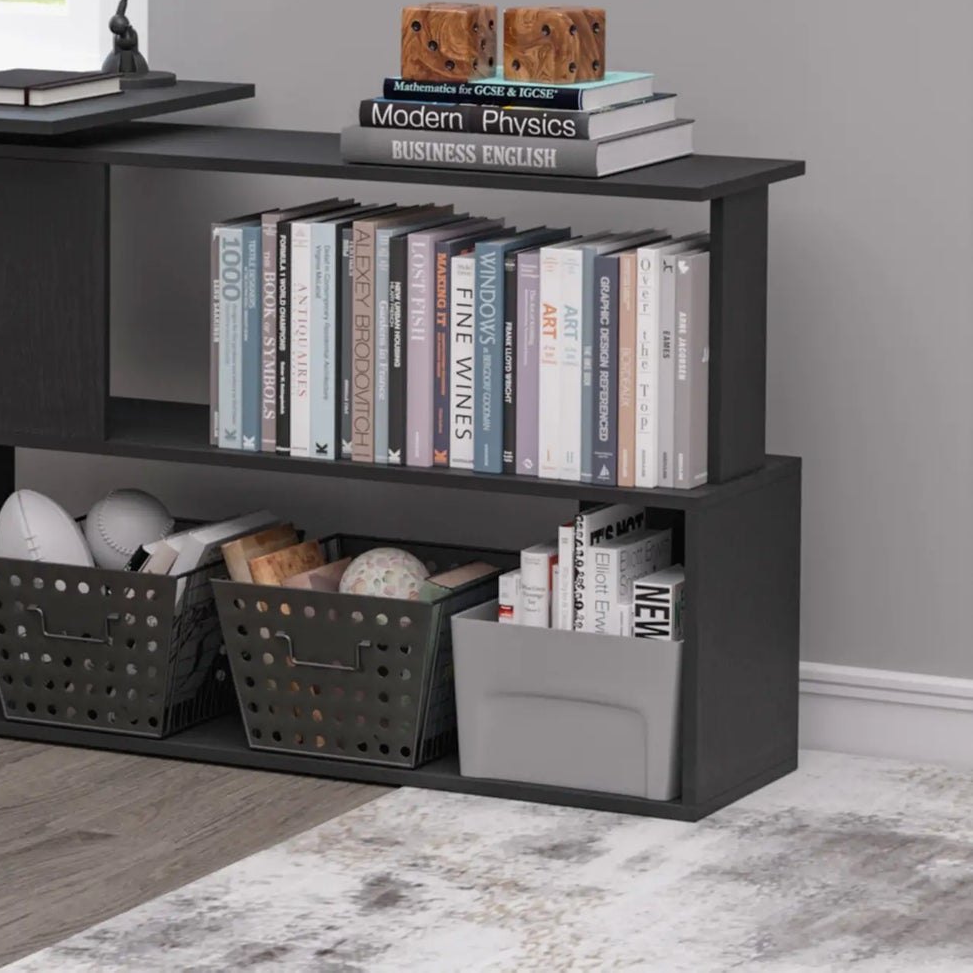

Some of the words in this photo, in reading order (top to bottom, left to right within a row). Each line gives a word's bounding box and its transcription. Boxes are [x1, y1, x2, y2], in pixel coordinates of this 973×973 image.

[393, 80, 457, 95] Mathematics
[458, 83, 473, 96] for
[474, 84, 505, 98] GCSE
[506, 86, 517, 98] &
[371, 101, 464, 131] Modern
[482, 109, 577, 138] Physics
[391, 139, 477, 164] BUSINESS
[482, 144, 557, 168] ENGLISH
[222, 237, 241, 302] 1000
[279, 235, 287, 271] FORMULA
[355, 229, 371, 308] ALEXEY
[411, 241, 426, 293] LOST
[263, 271, 275, 319] BOOK
[279, 278, 287, 306] WORLD
[436, 252, 447, 308] MAKING
[479, 252, 496, 345] WINDOWS
[599, 276, 610, 325] GRAPHIC
[279, 307, 287, 351] CHAMPIONS
[378, 300, 388, 345] Gardens
[411, 297, 426, 342] FISH
[436, 311, 447, 327] IT
[456, 287, 473, 344] FINE
[504, 321, 513, 346] FRANK
[542, 303, 557, 339] ART
[563, 305, 578, 341] ART
[678, 311, 687, 335] ARNE
[296, 283, 308, 398] ANTIQUAIRES
[379, 348, 388, 359] in
[504, 347, 513, 372] LLOYD
[599, 327, 610, 368] DESIGN
[662, 330, 671, 359] EAMES
[678, 336, 687, 380] JACOBSEN
[263, 336, 276, 420] SYMBOLS
[354, 315, 371, 447] BRODOVITCH
[378, 362, 388, 401] France
[455, 357, 473, 440] WINES
[504, 373, 512, 403] WRIGHT
[598, 370, 609, 441] REFERENCED
[595, 552, 611, 594] Elliott
